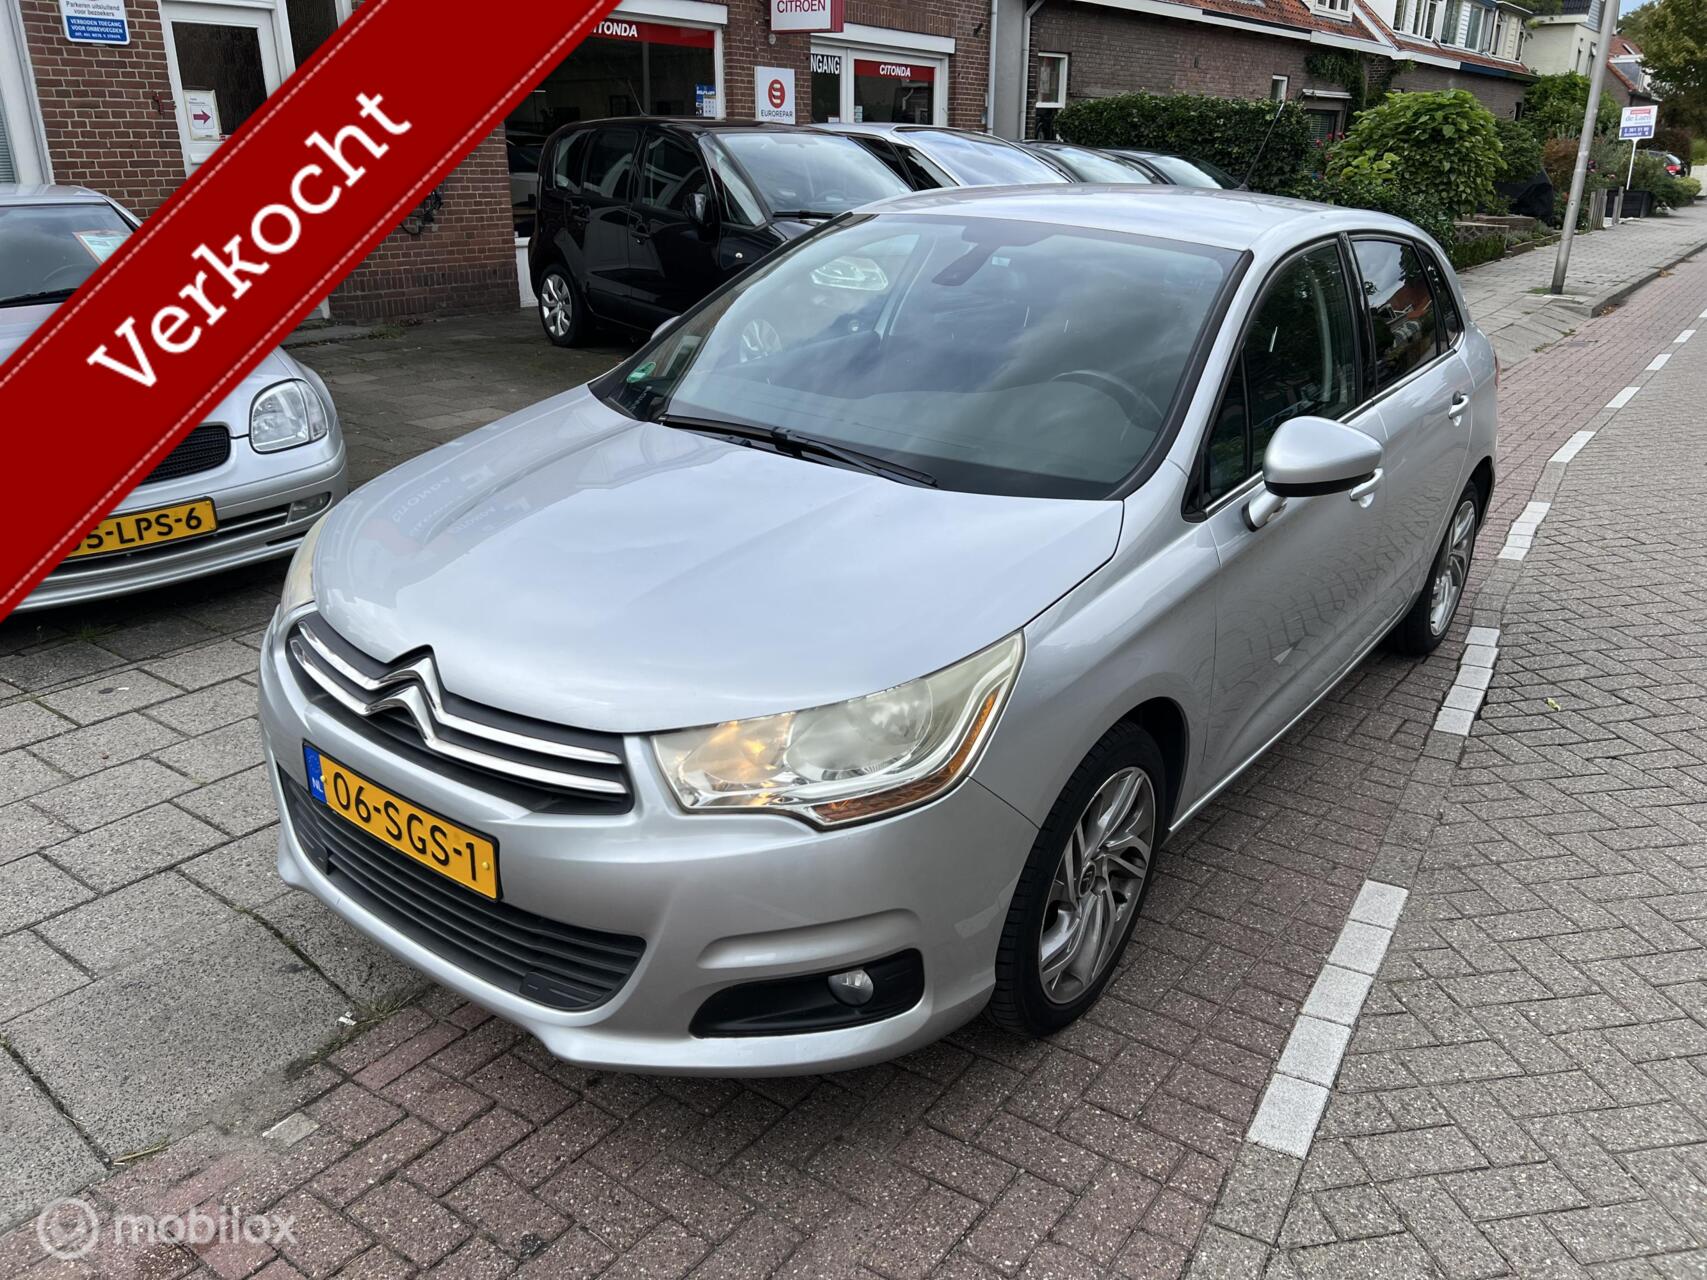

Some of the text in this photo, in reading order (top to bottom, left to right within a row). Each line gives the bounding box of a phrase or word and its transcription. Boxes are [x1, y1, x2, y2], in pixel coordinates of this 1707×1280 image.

[66, 1, 120, 11] Parkeren uitsluitend
[87, 9, 115, 17] bezoekers
[98, 20, 122, 28] TOEGANG
[593, 21, 638, 38] ITONDA
[810, 53, 840, 75] NGANG
[879, 64, 911, 77] CITONDA
[760, 109, 794, 118] EUROREPAR
[311, 777, 324, 794] NL
[333, 771, 478, 882] 06-SGS-1
